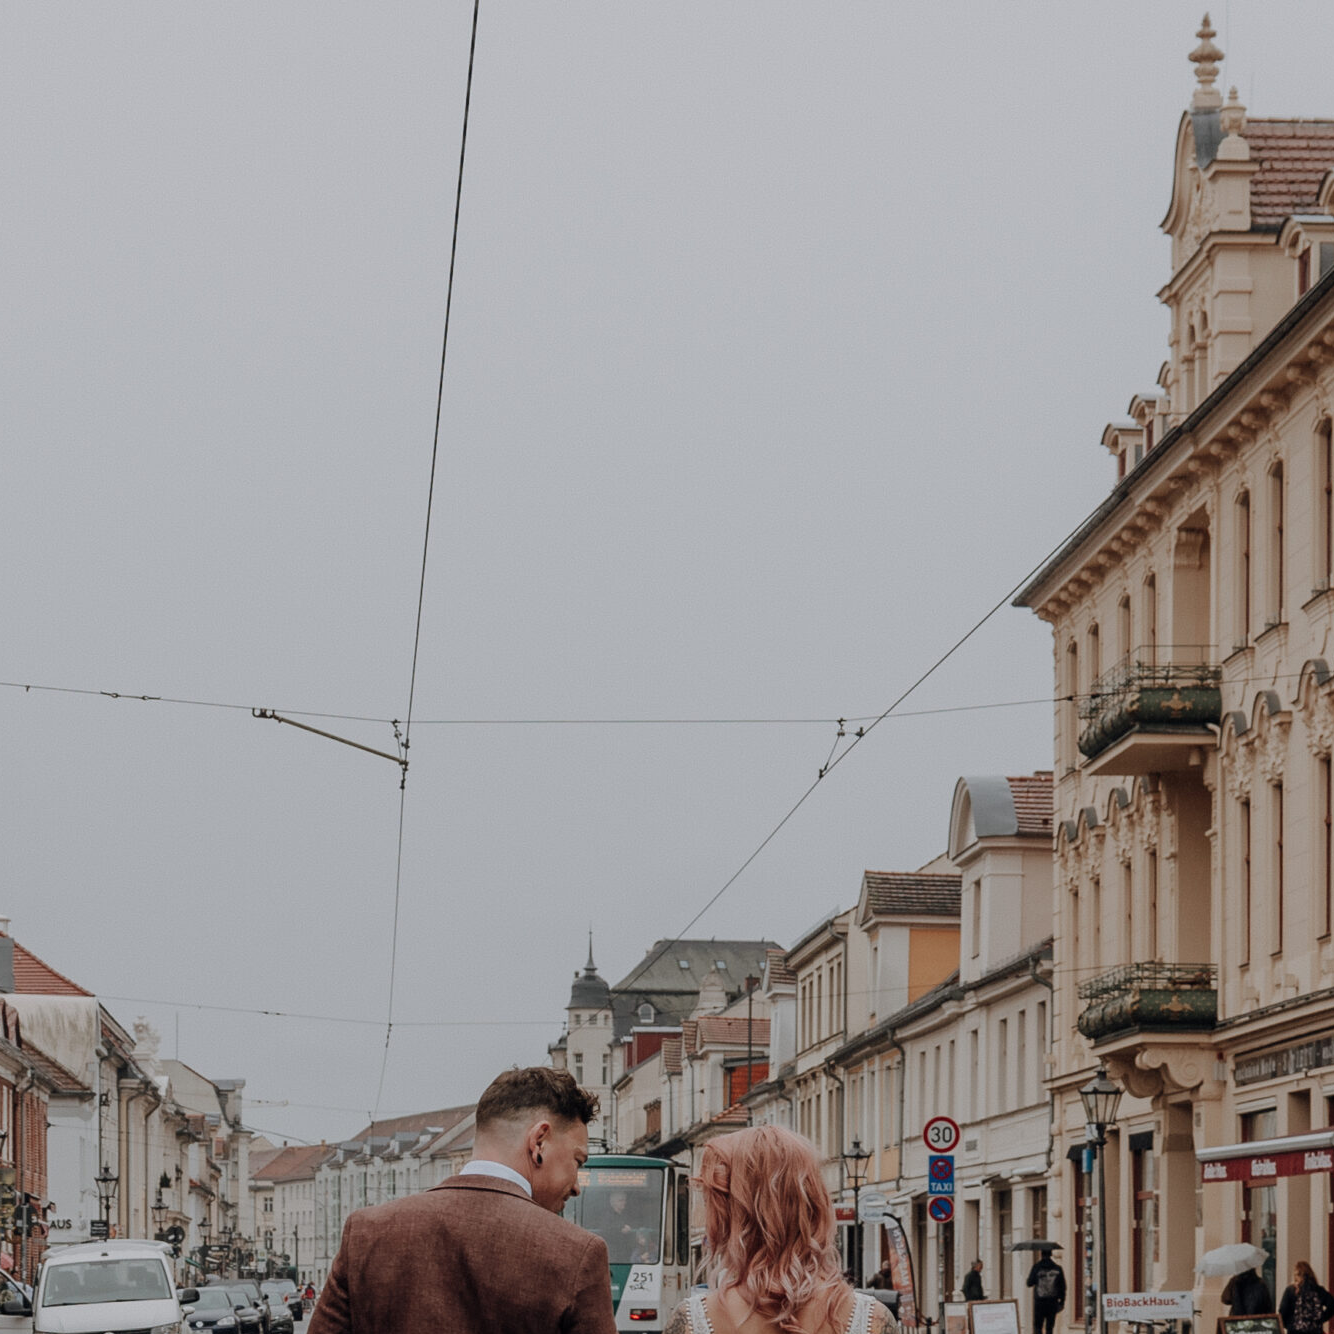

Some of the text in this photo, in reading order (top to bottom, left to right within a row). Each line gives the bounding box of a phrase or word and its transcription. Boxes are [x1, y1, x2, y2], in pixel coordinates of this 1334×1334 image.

[931, 1126, 953, 1144] 30
[931, 1182, 953, 1192] TAXI
[633, 1272, 653, 1283] 251
